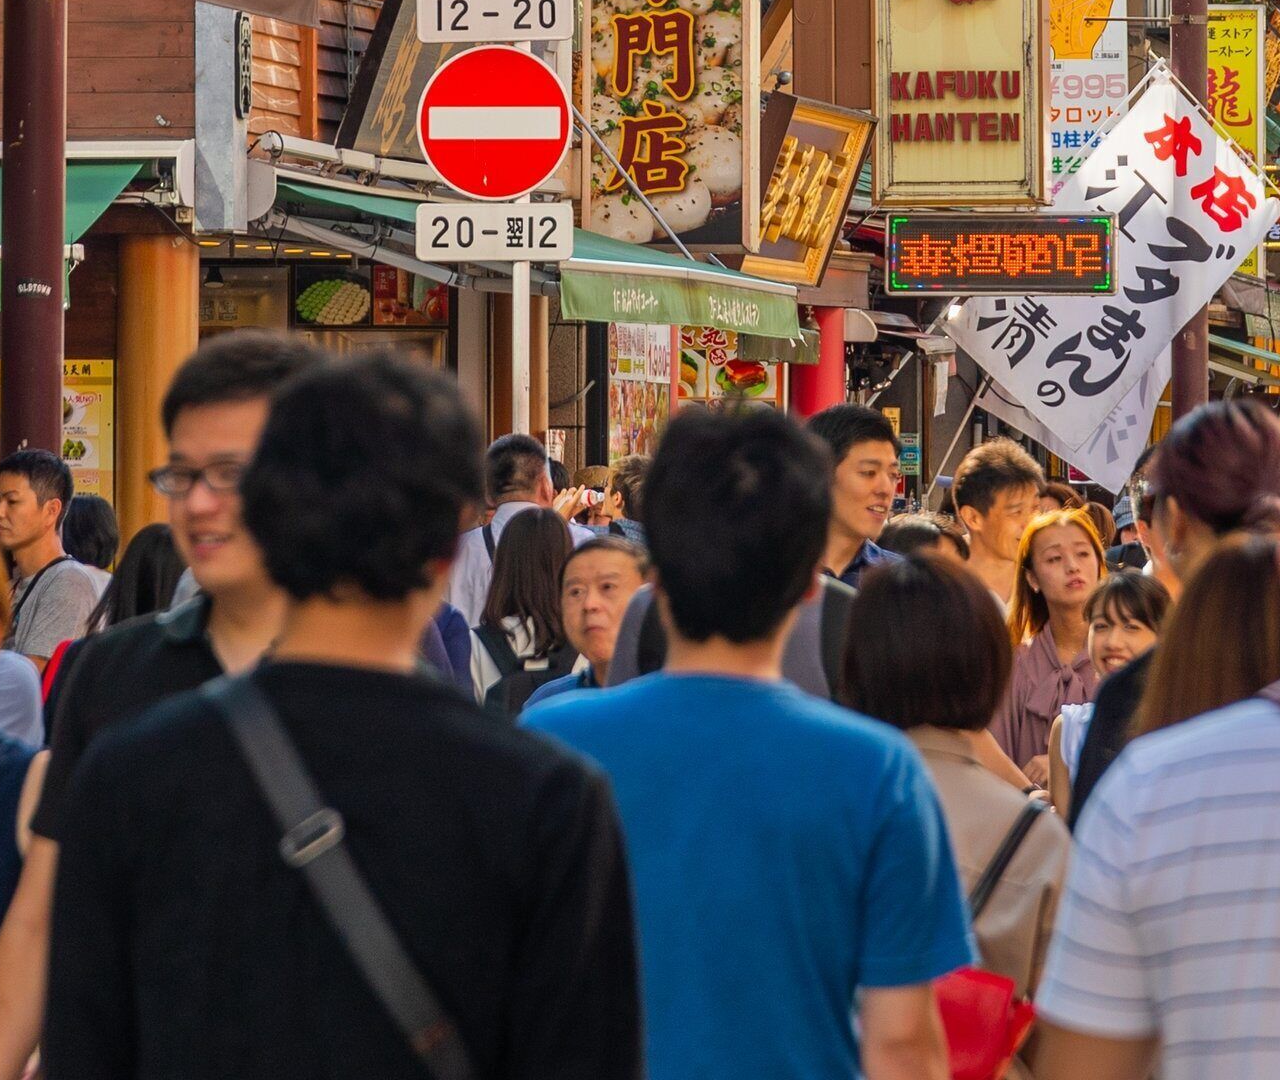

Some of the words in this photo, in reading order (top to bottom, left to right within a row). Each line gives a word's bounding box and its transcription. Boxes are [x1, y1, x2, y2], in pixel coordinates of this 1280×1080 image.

[890, 70, 1021, 102] KAFUKU
[890, 111, 1021, 145] HANTEN
[1143, 112, 1258, 233] 本店
[431, 215, 558, 249] 20-翌12
